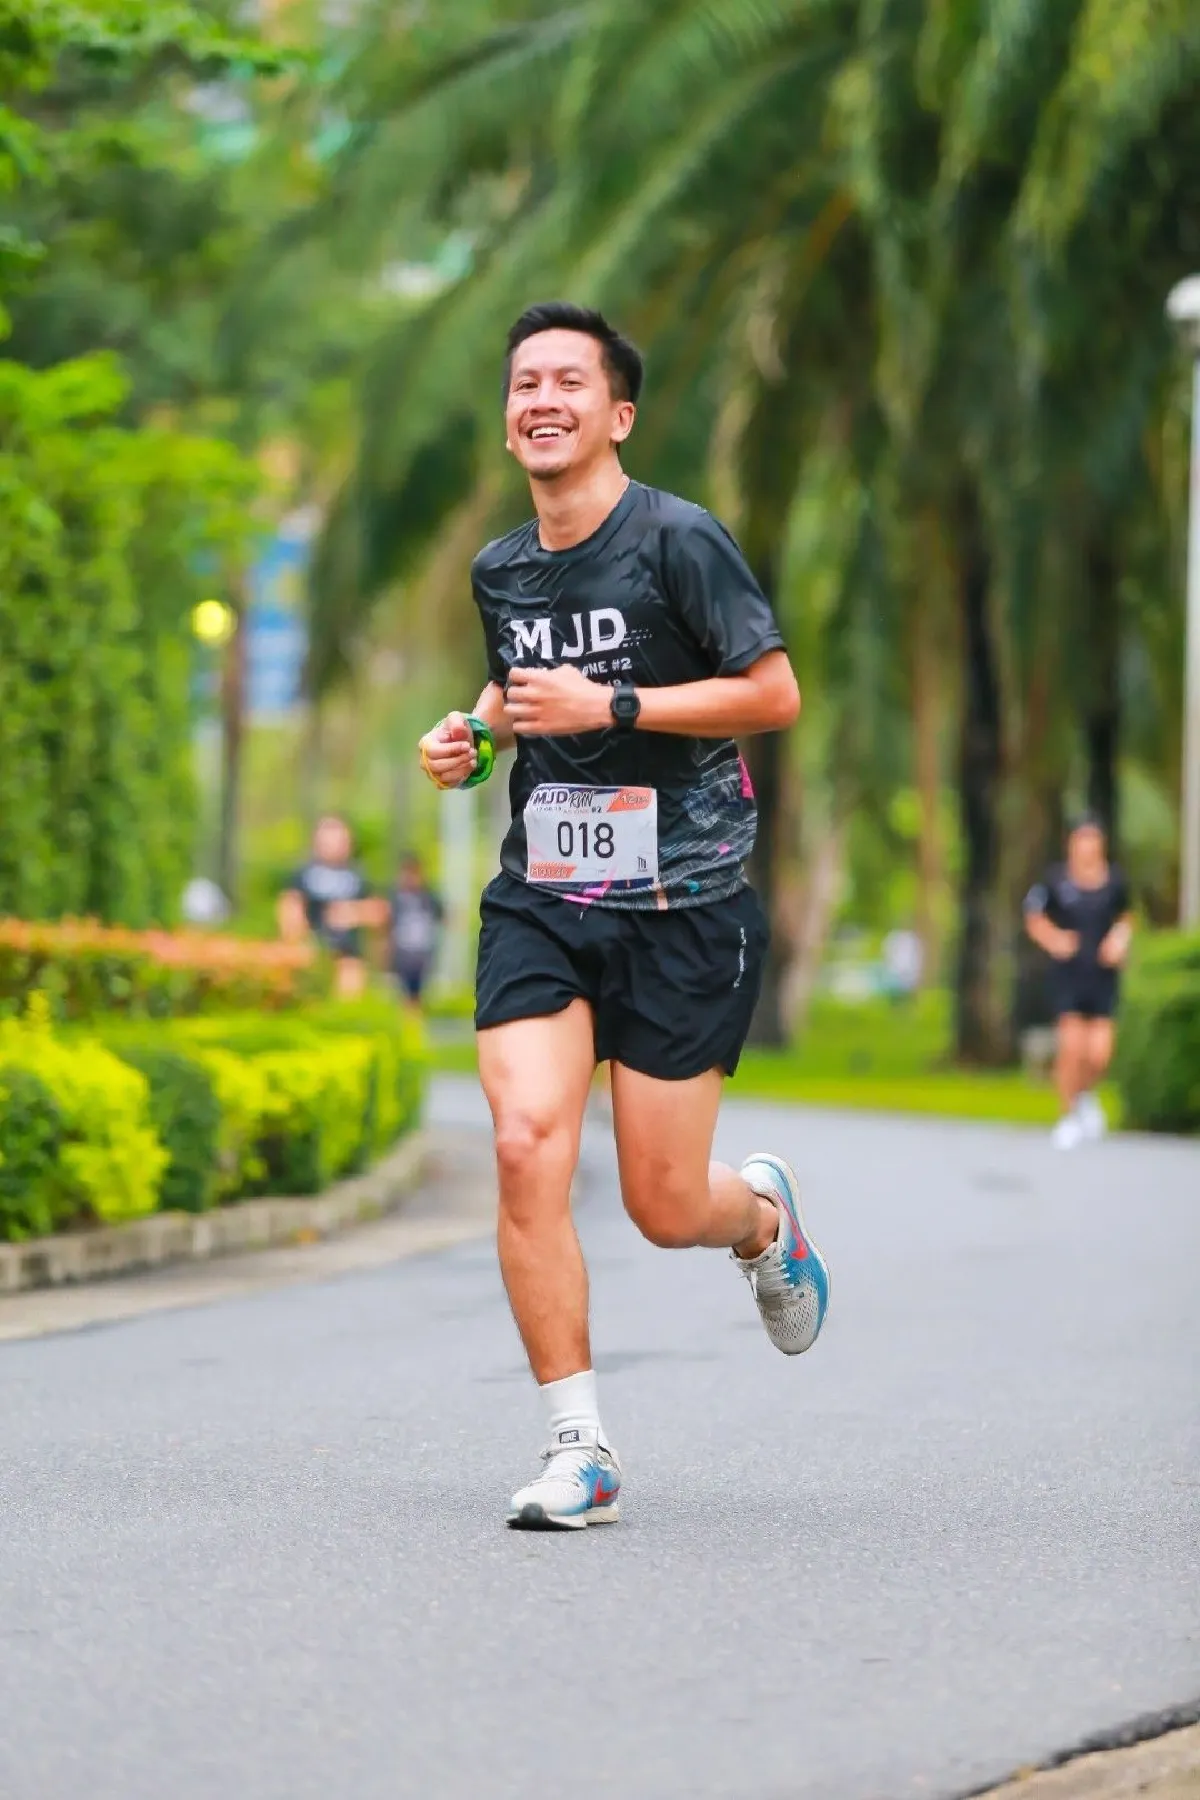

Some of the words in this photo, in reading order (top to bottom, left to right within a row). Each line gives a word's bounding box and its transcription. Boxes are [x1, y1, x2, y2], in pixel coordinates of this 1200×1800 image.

[510, 608, 626, 659] MJD
[612, 657, 632, 671] #2
[532, 790, 568, 805] MJD
[557, 821, 615, 858] 018
